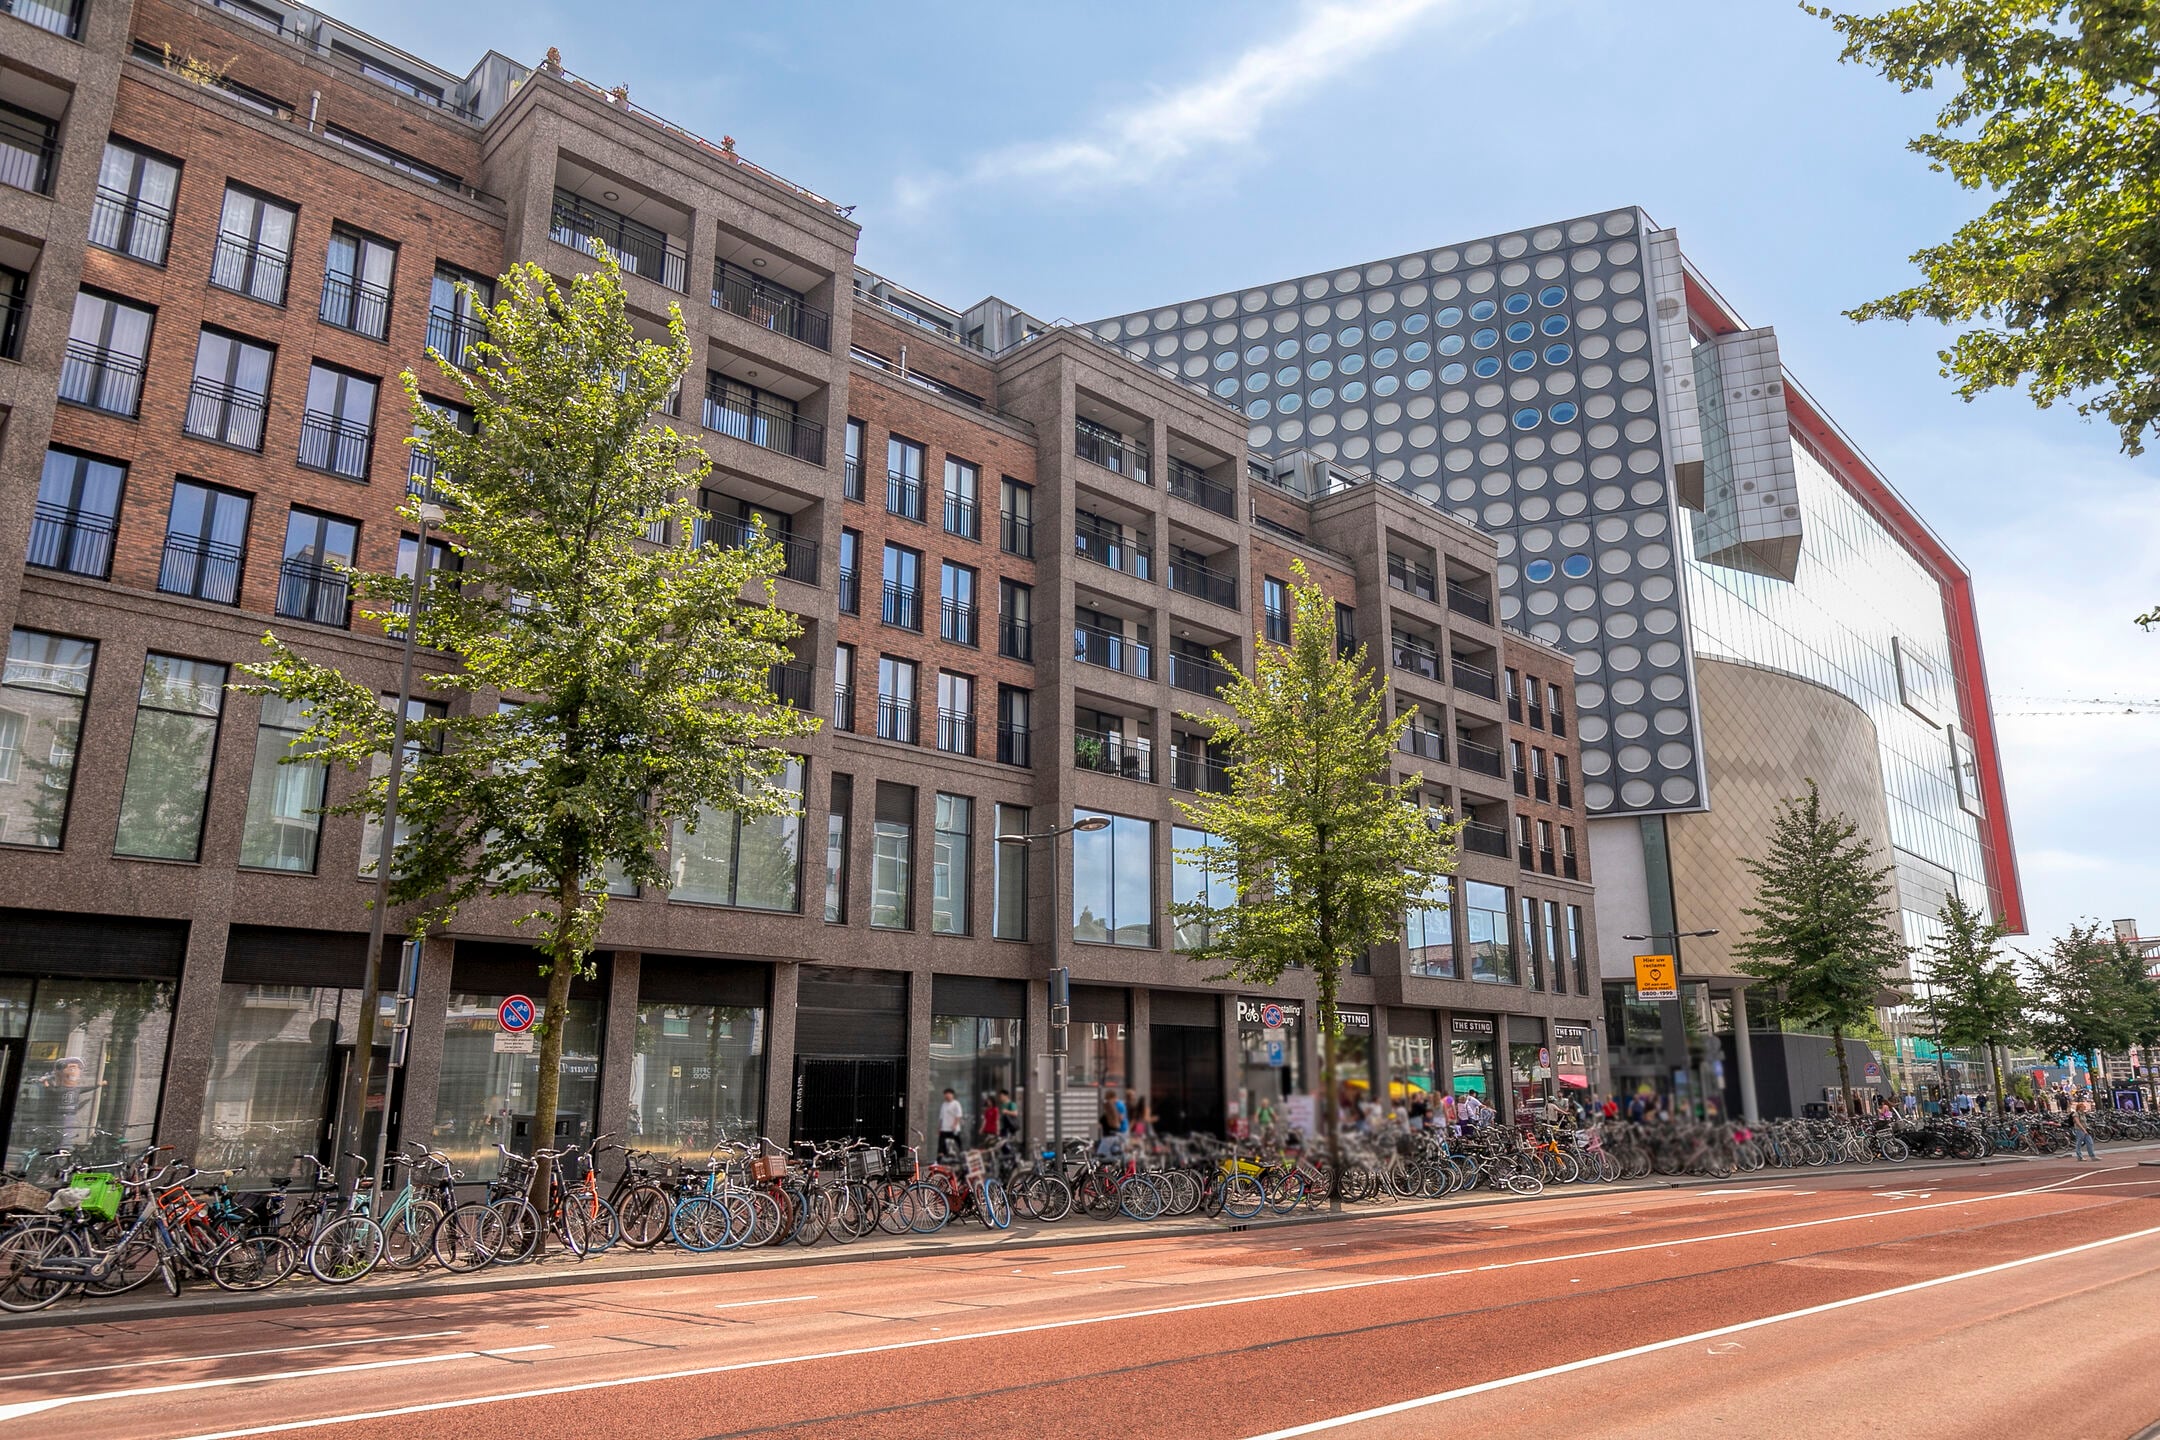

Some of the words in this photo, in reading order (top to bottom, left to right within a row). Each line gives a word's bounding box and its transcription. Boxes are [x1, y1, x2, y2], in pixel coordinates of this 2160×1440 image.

[1341, 1014, 1367, 1024] STING
[1455, 1021, 1469, 1030] THE
[1469, 1022, 1491, 1031] STING
[1556, 1028, 1568, 1036] THE
